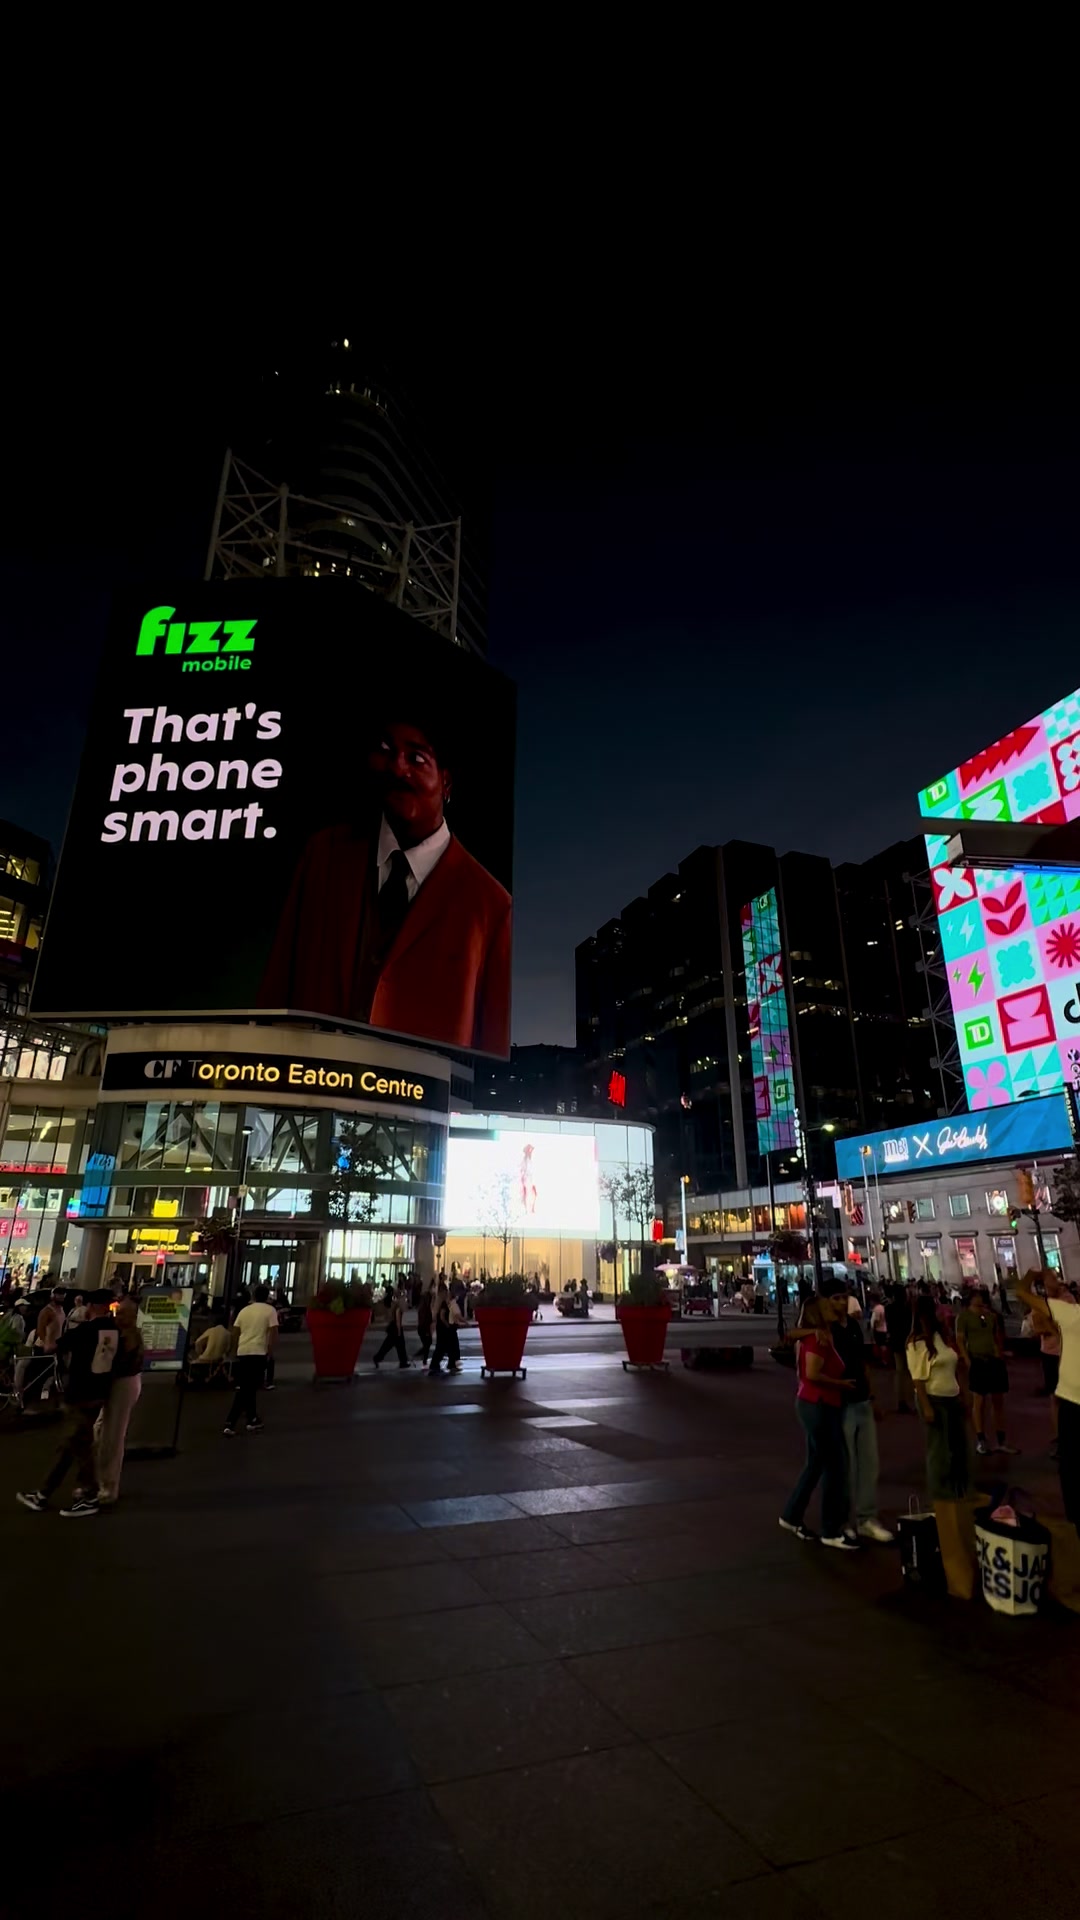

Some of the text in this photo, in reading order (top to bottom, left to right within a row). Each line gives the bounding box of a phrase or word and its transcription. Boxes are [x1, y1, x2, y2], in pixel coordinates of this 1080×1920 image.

[136, 605, 258, 656] fizz
[182, 655, 252, 672] mobile
[123, 702, 282, 744] That's
[109, 752, 283, 801] phone
[927, 781, 947, 802] TD
[100, 801, 277, 843] smart.
[967, 1021, 991, 1042] TD
[144, 1059, 425, 1101] CF Toronto Eaton Centre
[993, 1547, 1011, 1573] &
